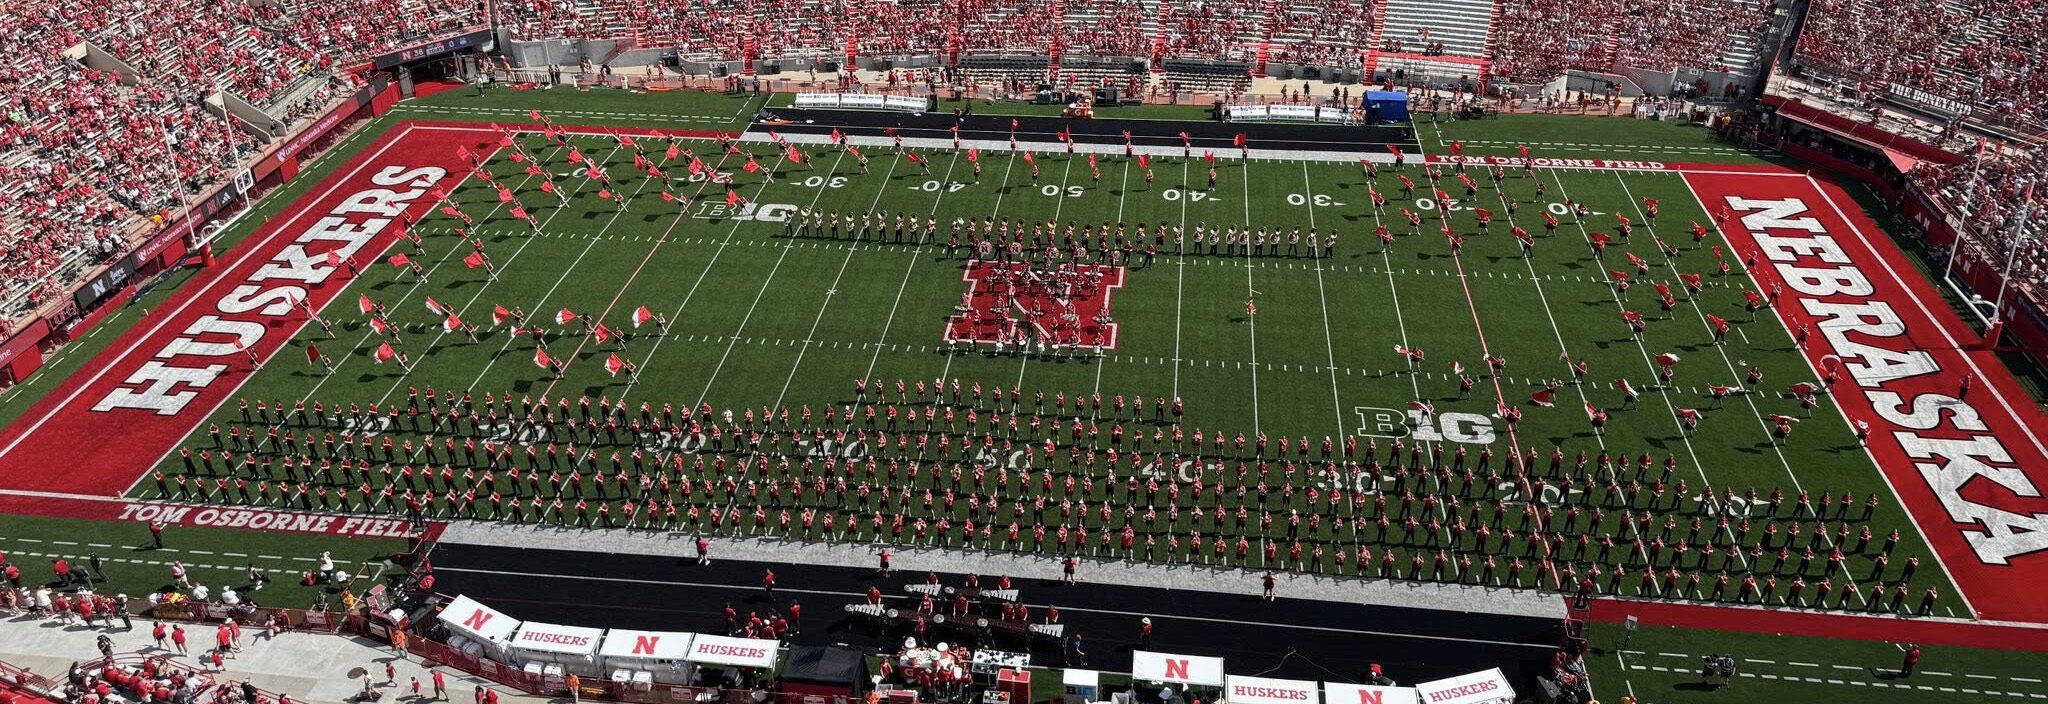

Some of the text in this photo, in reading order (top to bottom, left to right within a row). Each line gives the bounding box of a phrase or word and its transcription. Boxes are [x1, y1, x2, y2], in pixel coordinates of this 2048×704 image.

[1890, 82, 1972, 116] THE BONEYARD
[301, 127, 320, 143] Nebraska
[320, 114, 338, 130] Medicine
[1436, 155, 1665, 169] TOM OSORNE FIELD
[805, 176, 848, 188] 30
[922, 180, 965, 192] 40
[1041, 184, 1084, 197] 50
[1162, 189, 1207, 201] 40
[1287, 193, 1332, 206] 30
[162, 226, 182, 241] Nebraska
[182, 212, 202, 228] Mecine
[90, 165, 448, 416] HUSKERS
[92, 280, 106, 297] N
[1724, 195, 2048, 565] NEBRASKA
[640, 431, 707, 455] 30
[1142, 460, 1203, 483] 40
[1498, 481, 1565, 508] 20
[118, 503, 188, 523] TOM
[194, 508, 336, 533] OSBORNE
[463, 608, 493, 631] N
[522, 630, 591, 646] HUSKERS
[632, 635, 660, 655] N
[697, 643, 766, 658] HUSKERS
[1165, 658, 1189, 679] N
[1234, 685, 1308, 700] HUSKERS
[1358, 689, 1383, 704] N
[1428, 680, 1499, 702] HUSKERS
